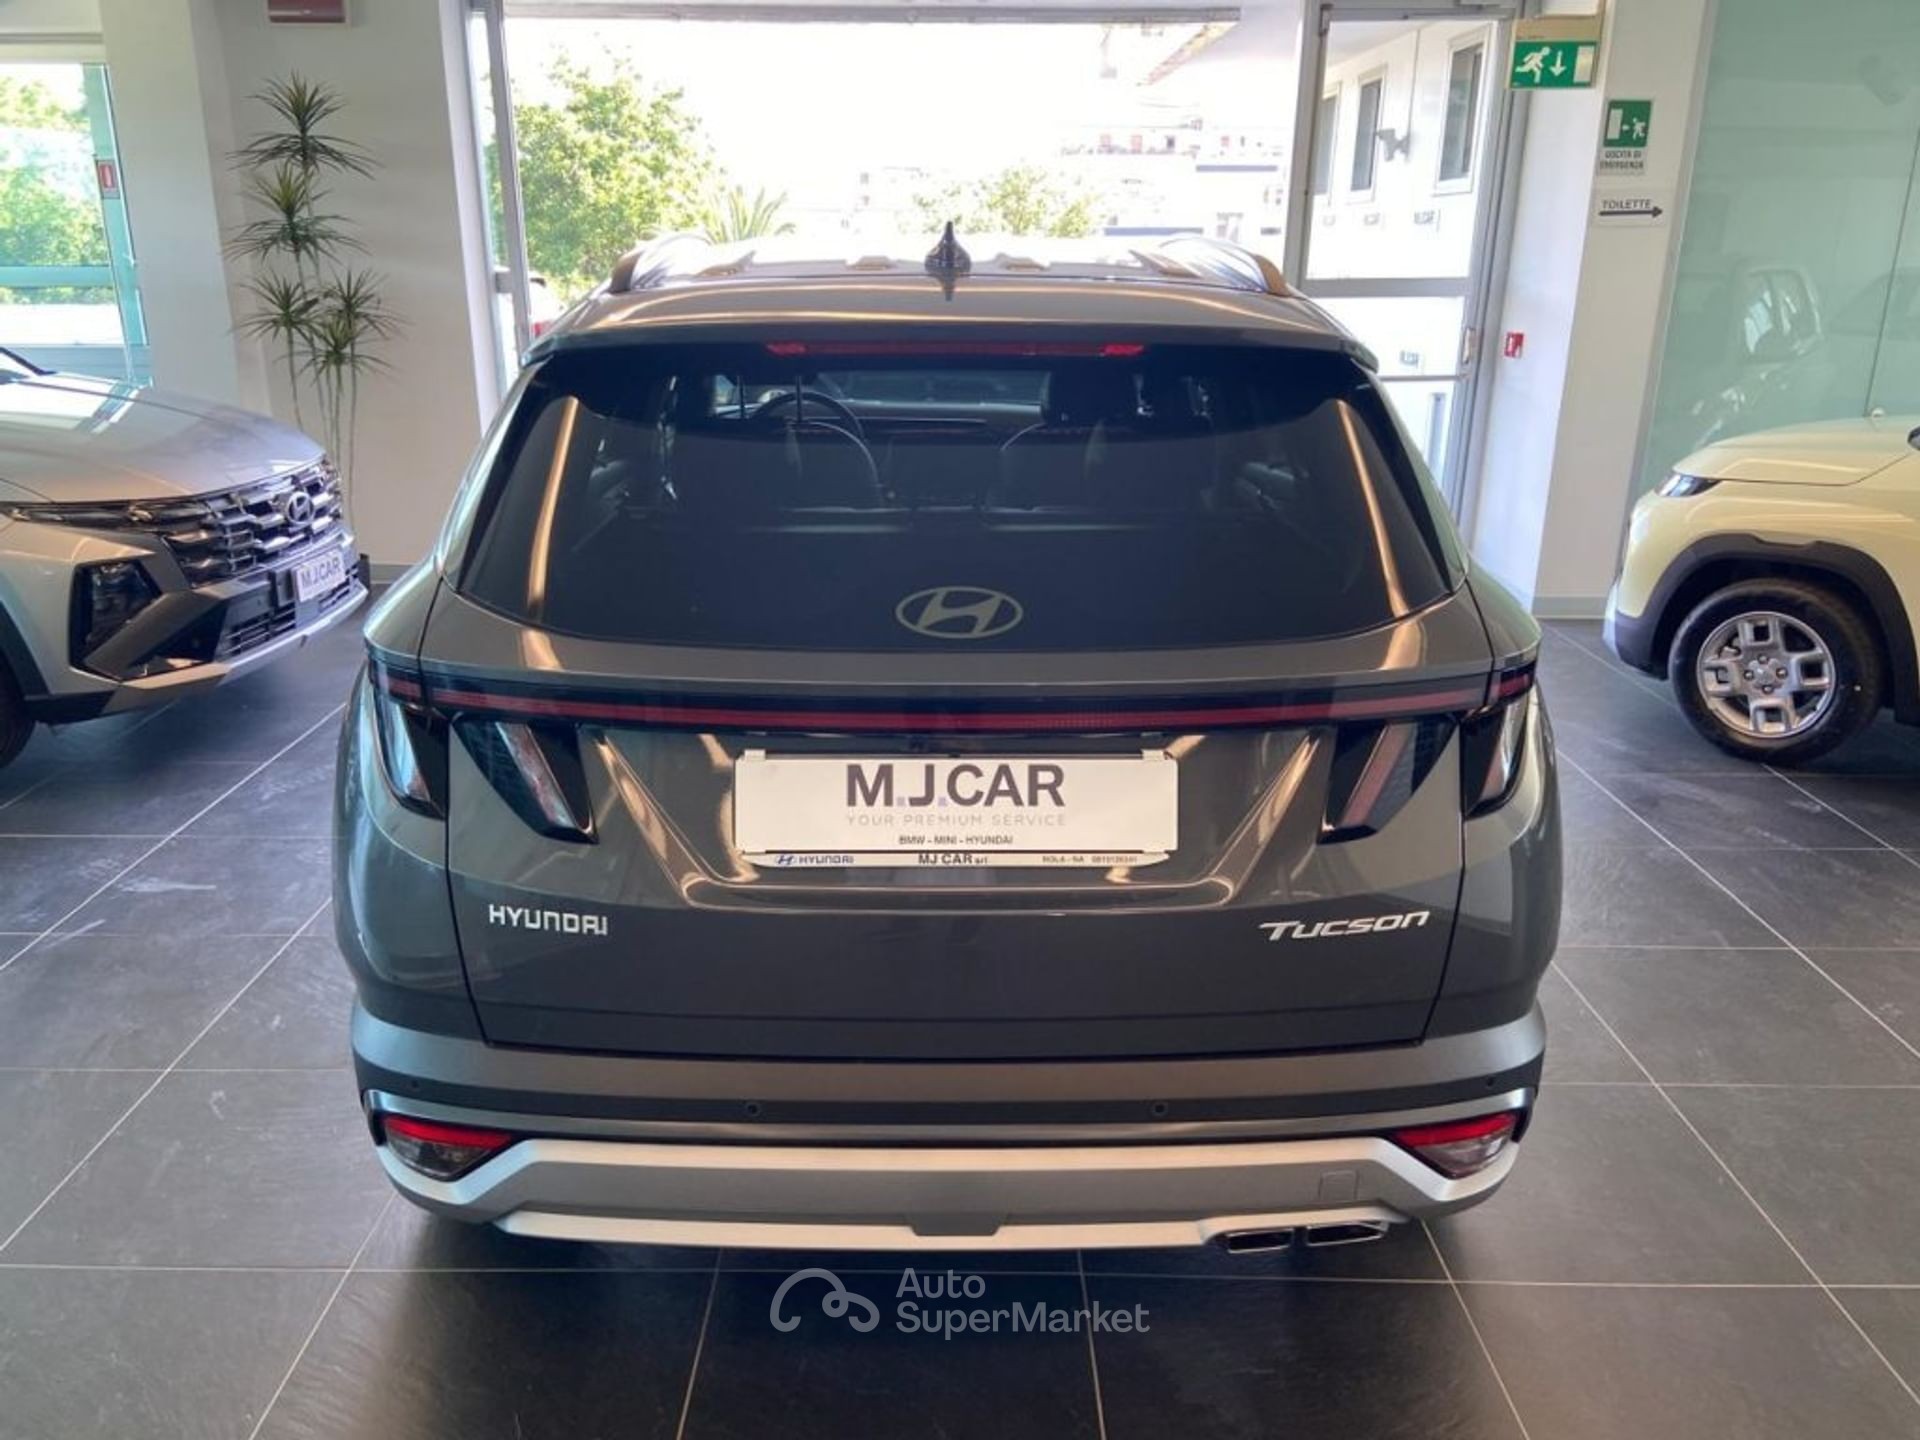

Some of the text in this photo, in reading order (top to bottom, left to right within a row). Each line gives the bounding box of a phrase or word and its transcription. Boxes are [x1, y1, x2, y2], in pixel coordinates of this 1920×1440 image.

[1602, 199, 1652, 209] TOILETTE
[847, 814, 1066, 827] YOUR PREMIUM SERVICE
[898, 835, 925, 845] BMW
[934, 835, 958, 845] MINI
[965, 835, 1014, 845] HYUNDAI
[799, 855, 854, 864] HYUNDAI
[918, 853, 938, 864] MJ
[941, 853, 974, 864] CAR
[488, 903, 608, 936] HYUNDAI
